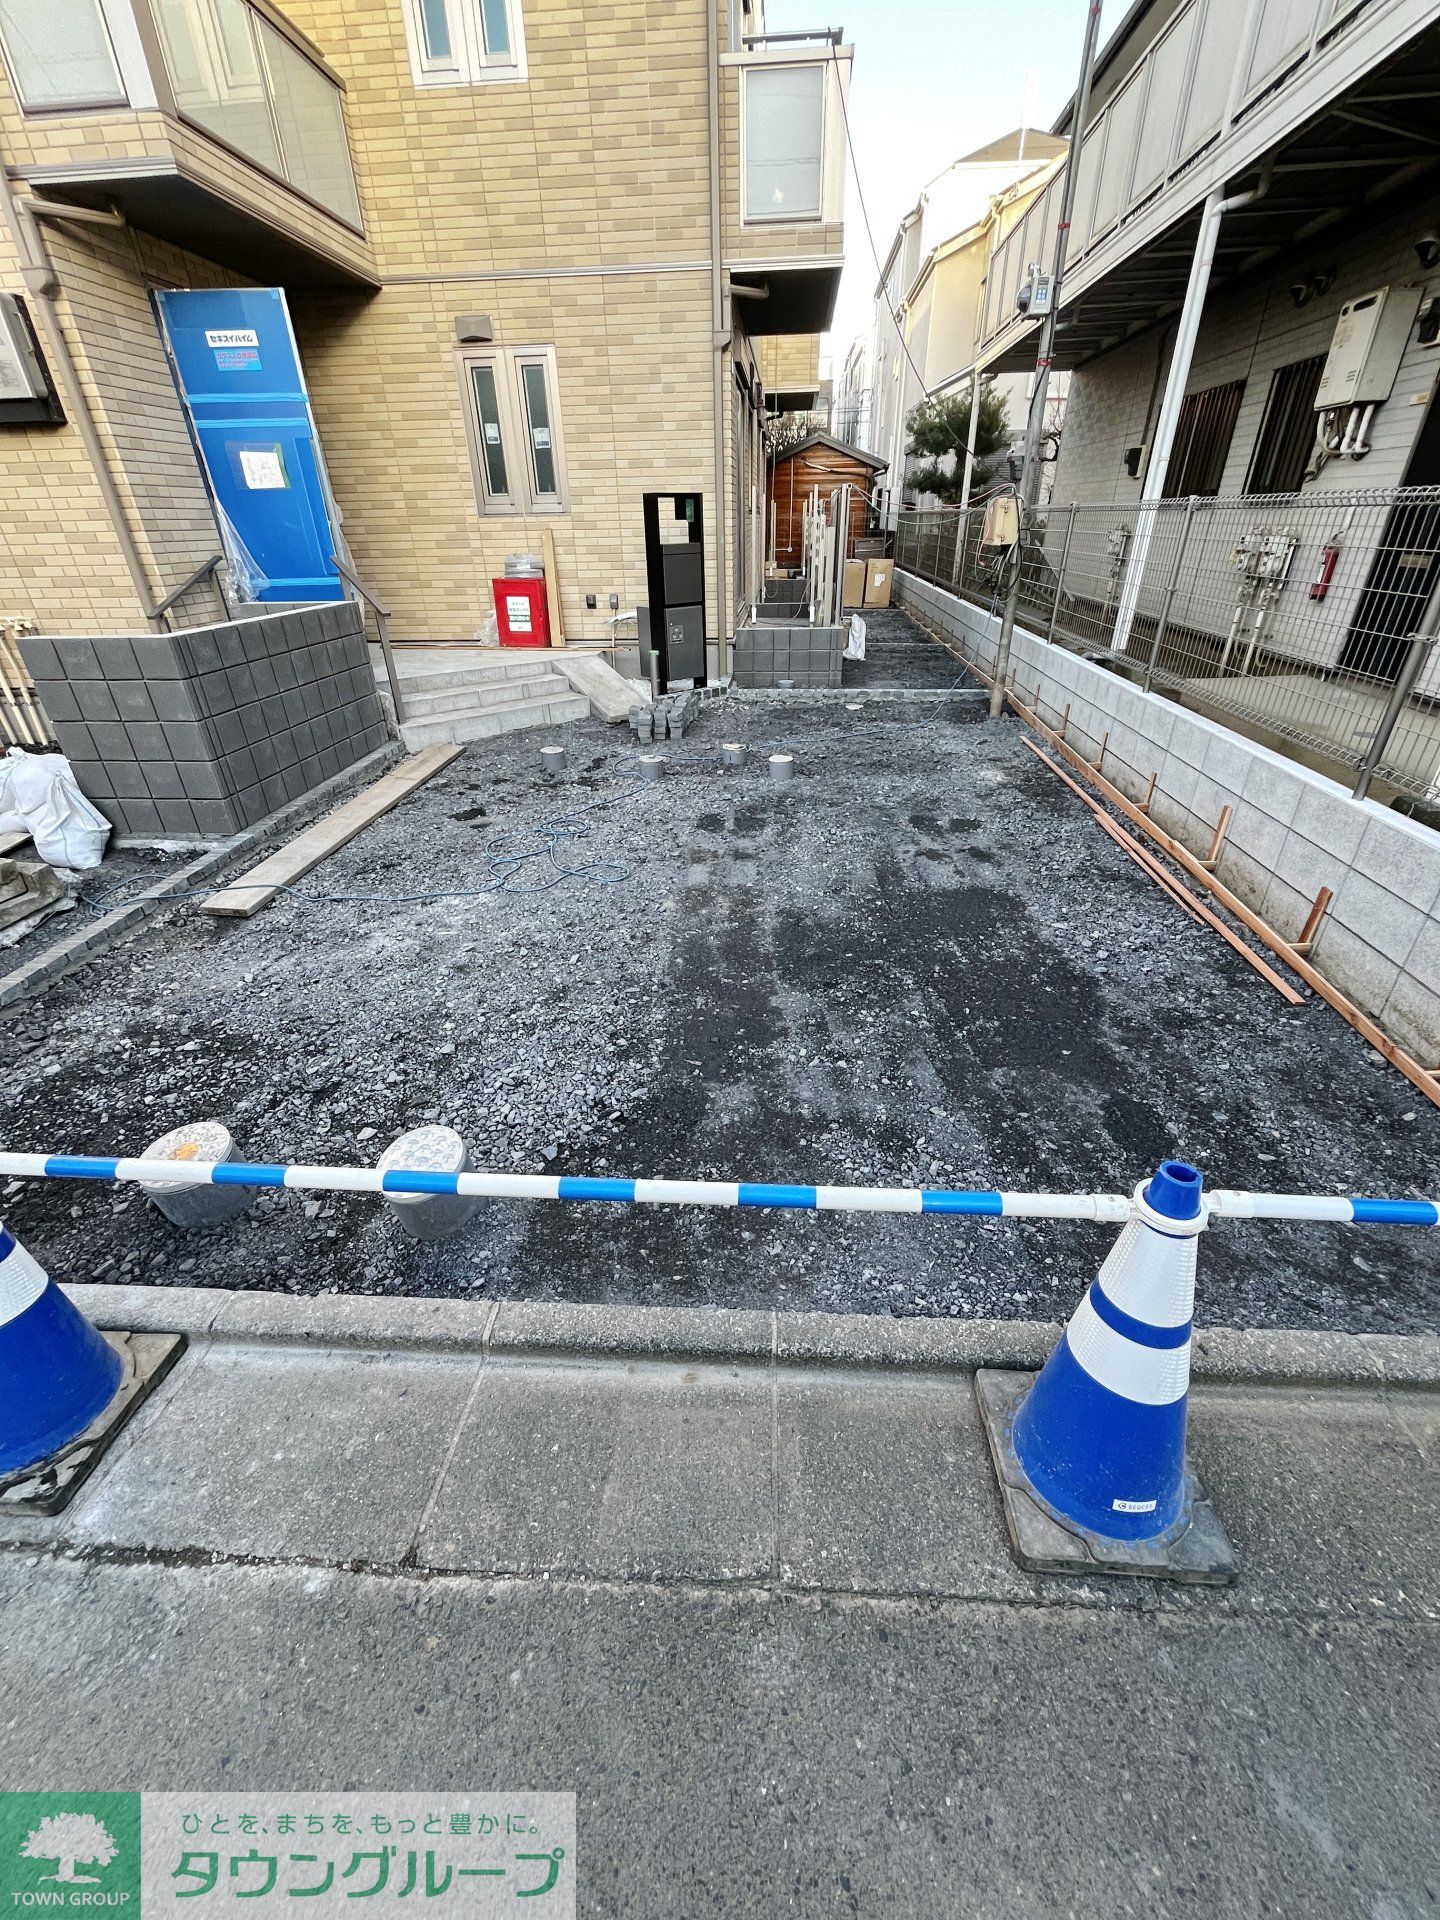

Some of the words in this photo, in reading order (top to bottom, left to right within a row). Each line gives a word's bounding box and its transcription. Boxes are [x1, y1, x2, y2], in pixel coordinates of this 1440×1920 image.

[209, 334, 254, 343] セキスイハイム
